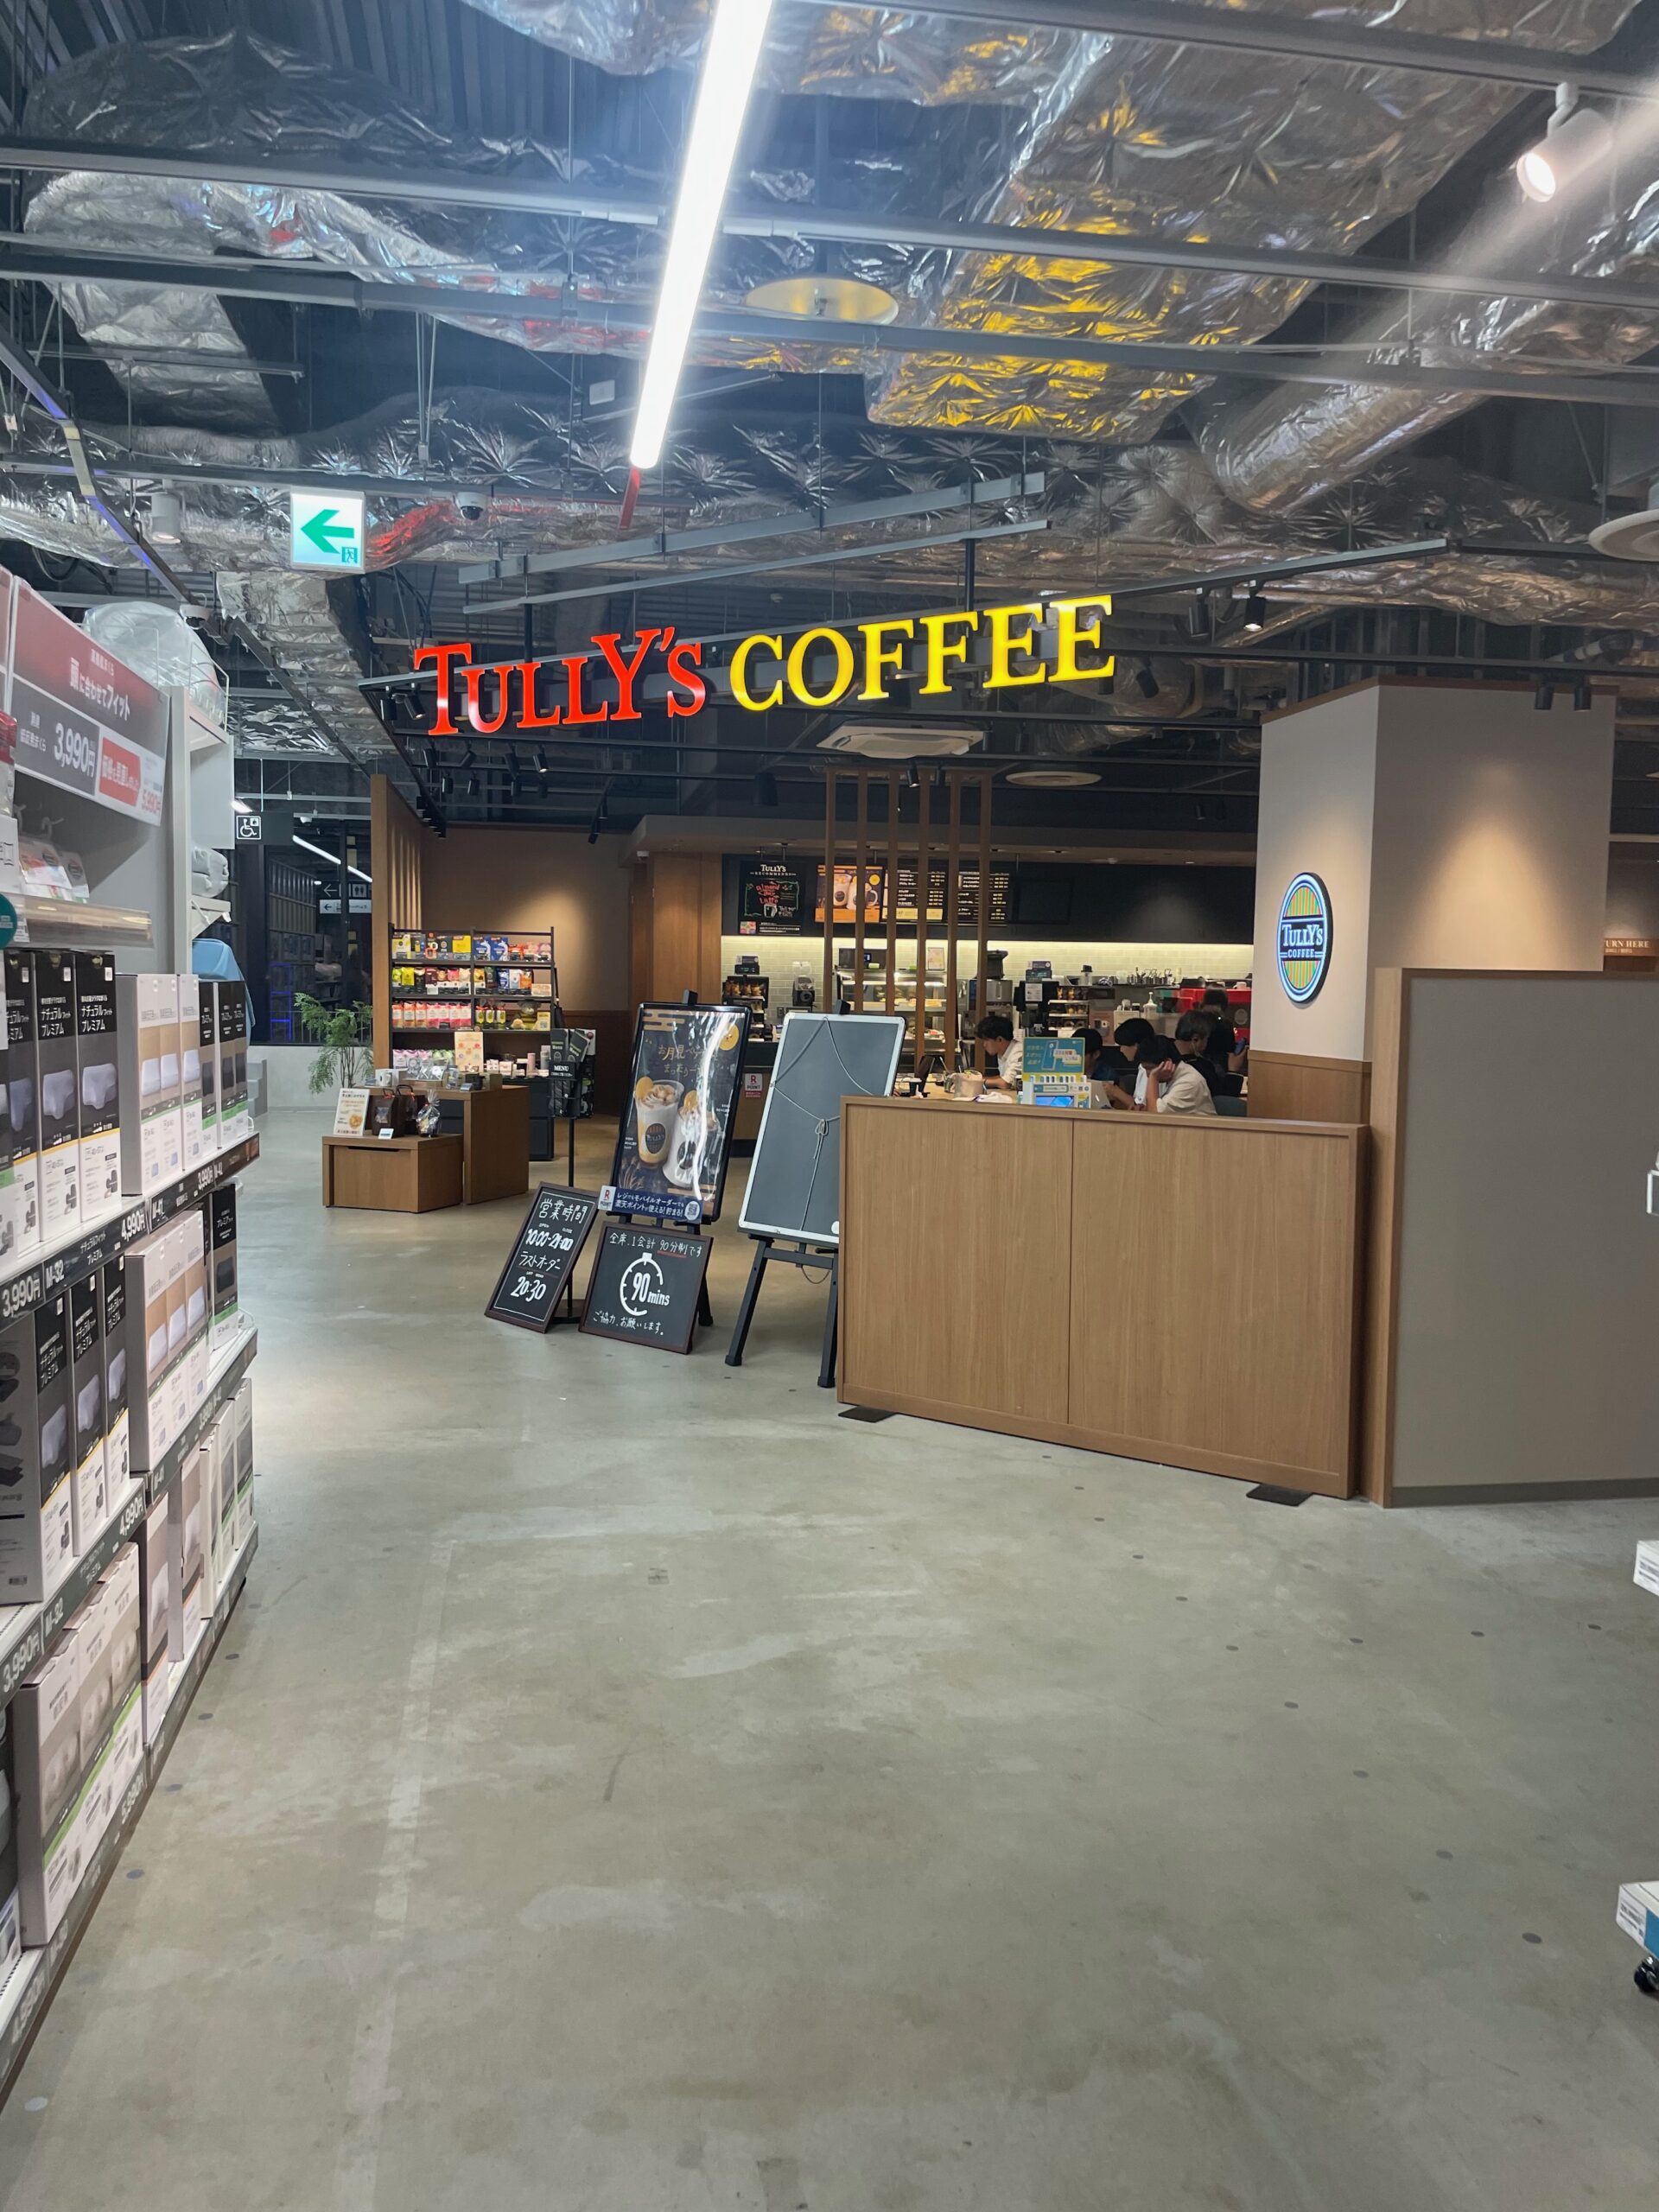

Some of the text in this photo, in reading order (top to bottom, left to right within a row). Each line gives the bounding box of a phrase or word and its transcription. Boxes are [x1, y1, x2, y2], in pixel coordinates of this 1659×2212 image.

[414, 594, 1116, 735] TULLY'S COFFEE
[54, 722, 96, 779] 3,990円
[1281, 924, 1324, 947] TULLY'S
[1287, 948, 1315, 958] COFFEE
[41, 1022, 65, 1037] プレミアム
[81, 1019, 105, 1033] プレミアム
[539, 1198, 588, 1224] 営業時間
[121, 1210, 146, 1242] 4,990円
[518, 1250, 561, 1271] ラストオーダー
[3, 1274, 41, 1318] 3,990円
[510, 1275, 547, 1302] 20:30
[631, 1272, 671, 1306] 90 mins
[3, 1631, 41, 1694] 3,990円
